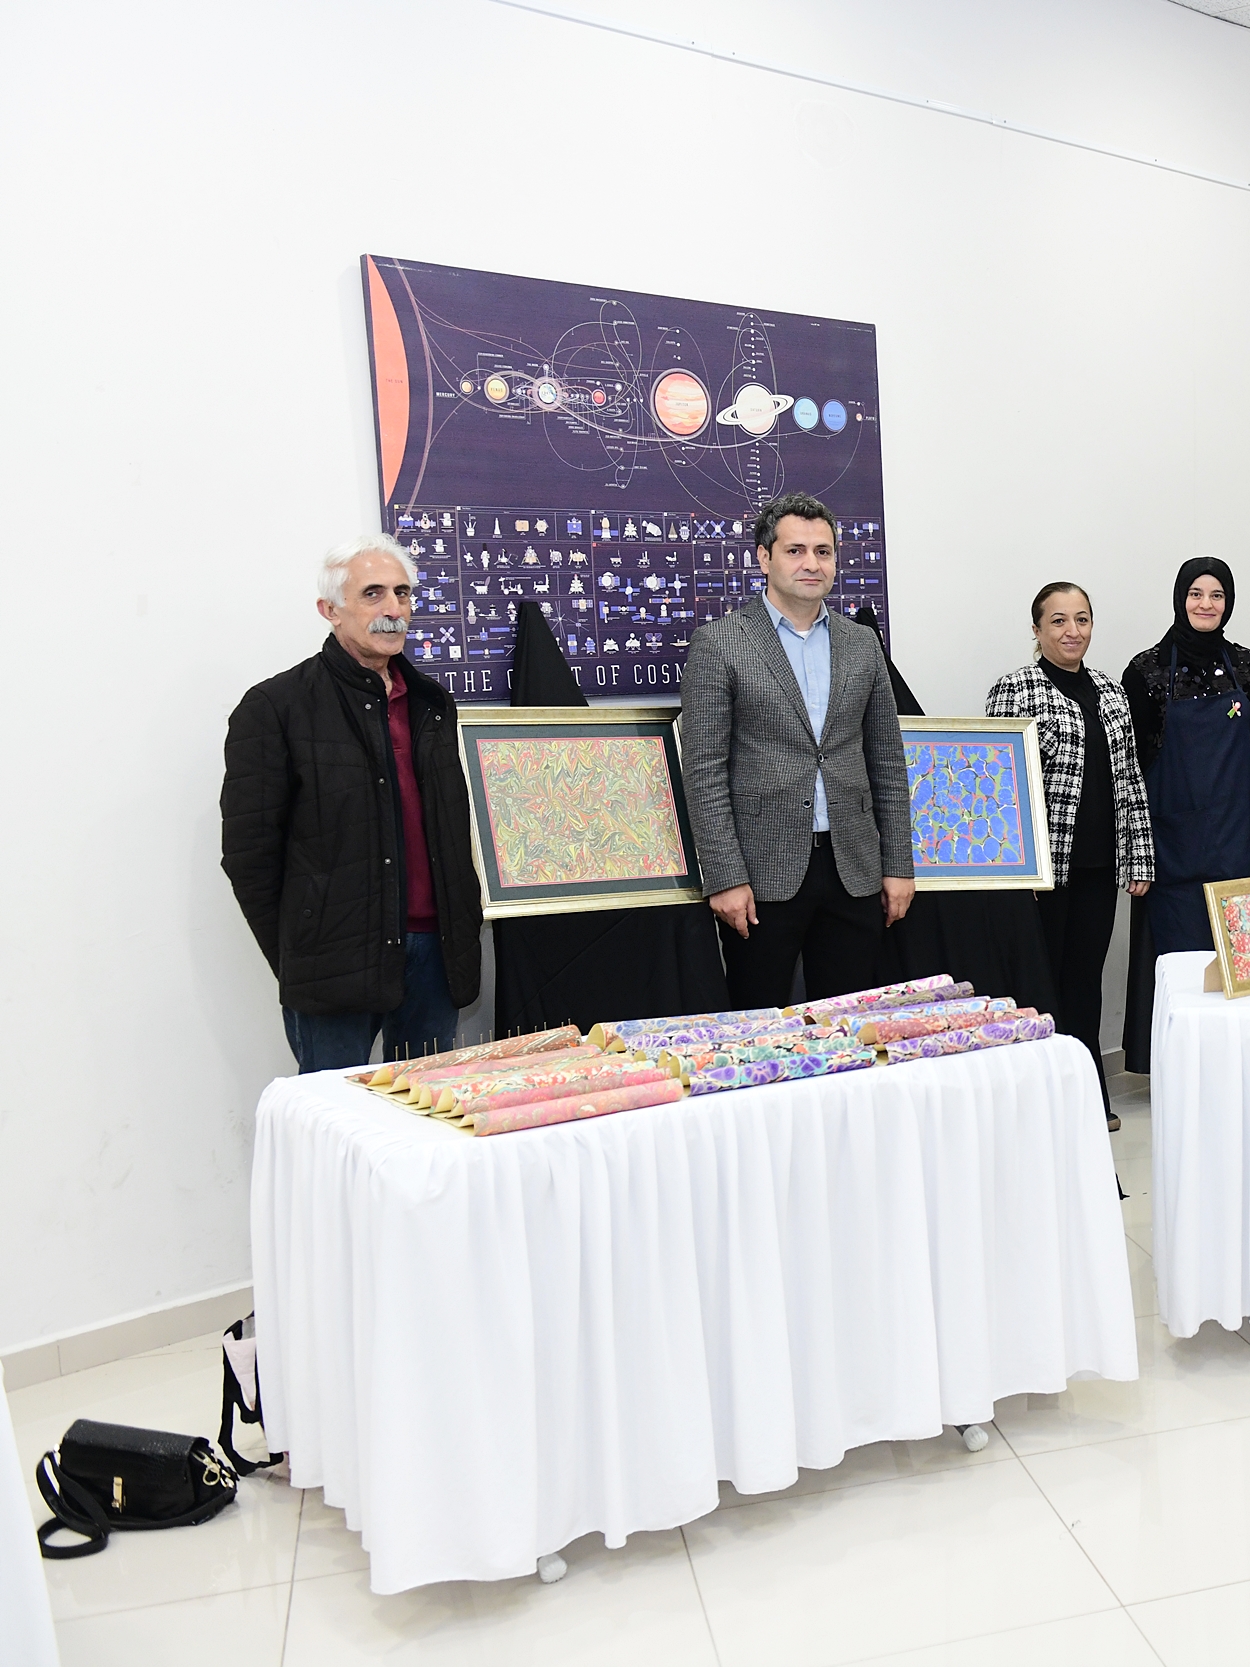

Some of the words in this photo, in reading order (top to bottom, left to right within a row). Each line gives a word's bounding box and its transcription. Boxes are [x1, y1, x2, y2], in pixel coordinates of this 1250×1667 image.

[445, 669, 493, 693] THE
[596, 664, 620, 686] OF
[633, 662, 687, 685] COSM
